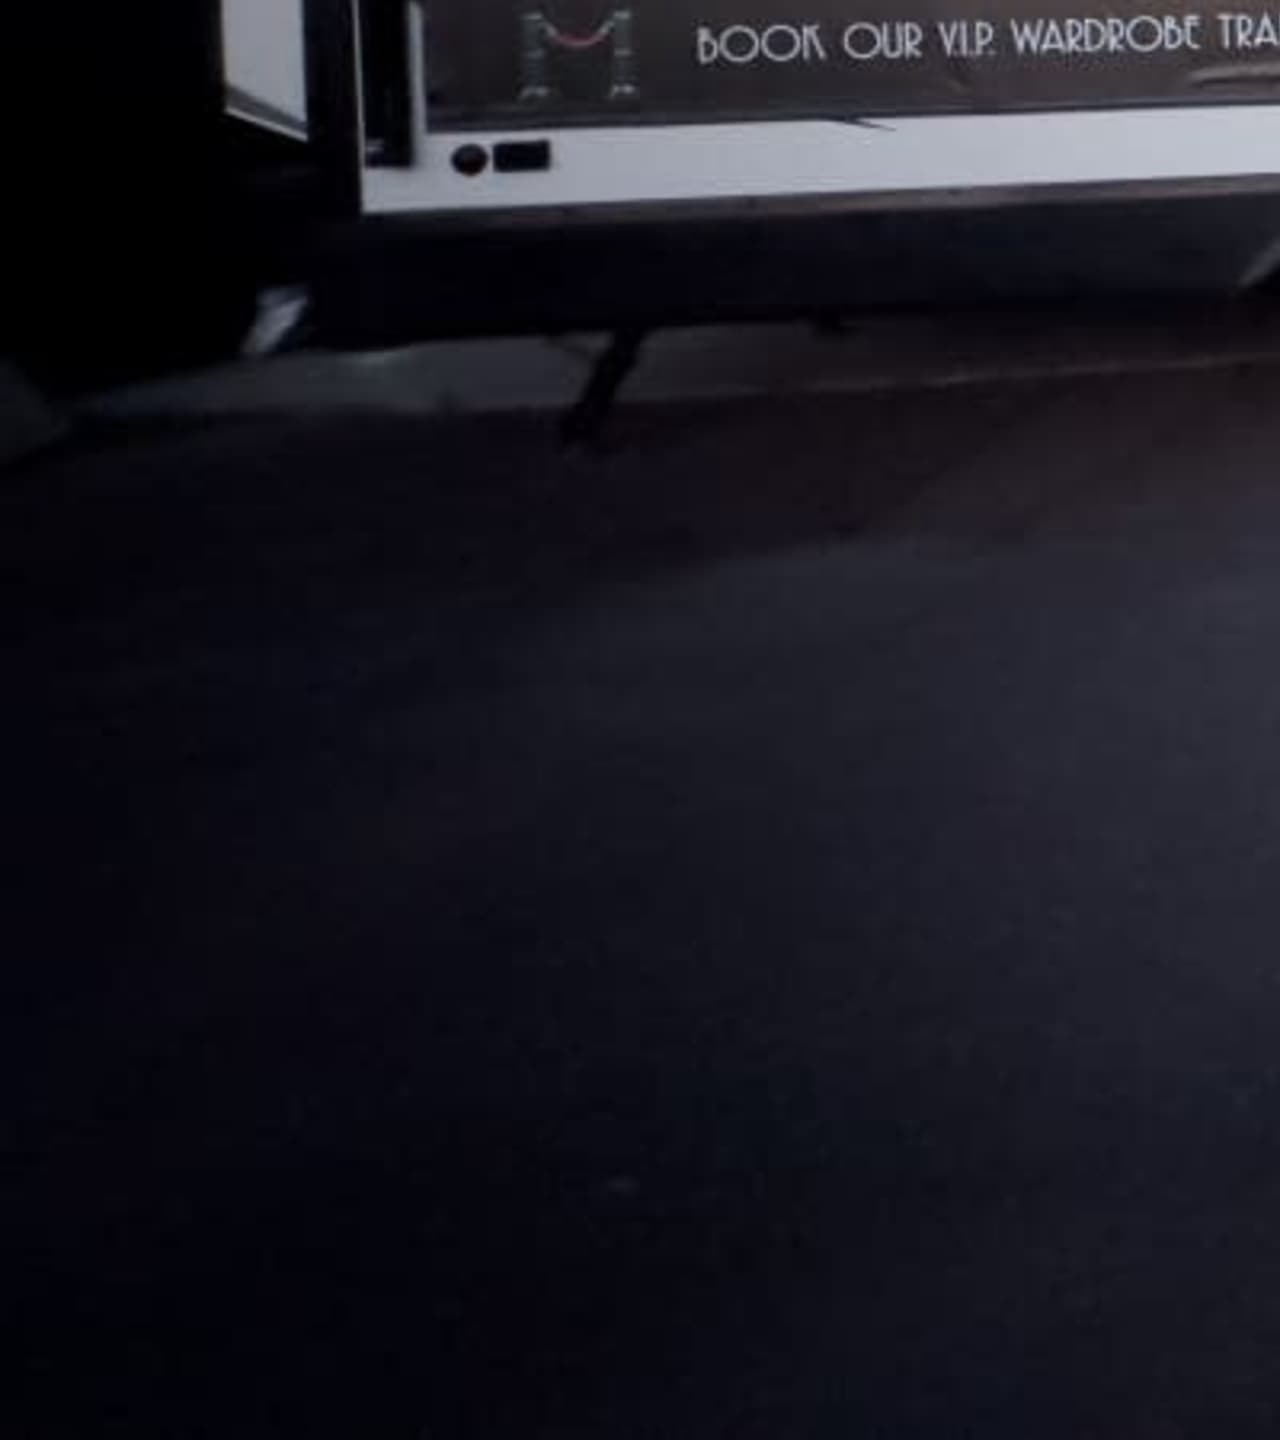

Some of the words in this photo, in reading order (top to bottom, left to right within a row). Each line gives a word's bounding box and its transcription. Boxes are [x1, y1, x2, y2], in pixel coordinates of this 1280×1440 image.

[697, 23, 826, 64] BOOK
[842, 21, 924, 60] OUR
[938, 19, 997, 58] V.I.P.
[1010, 13, 1201, 56] WARDROBE
